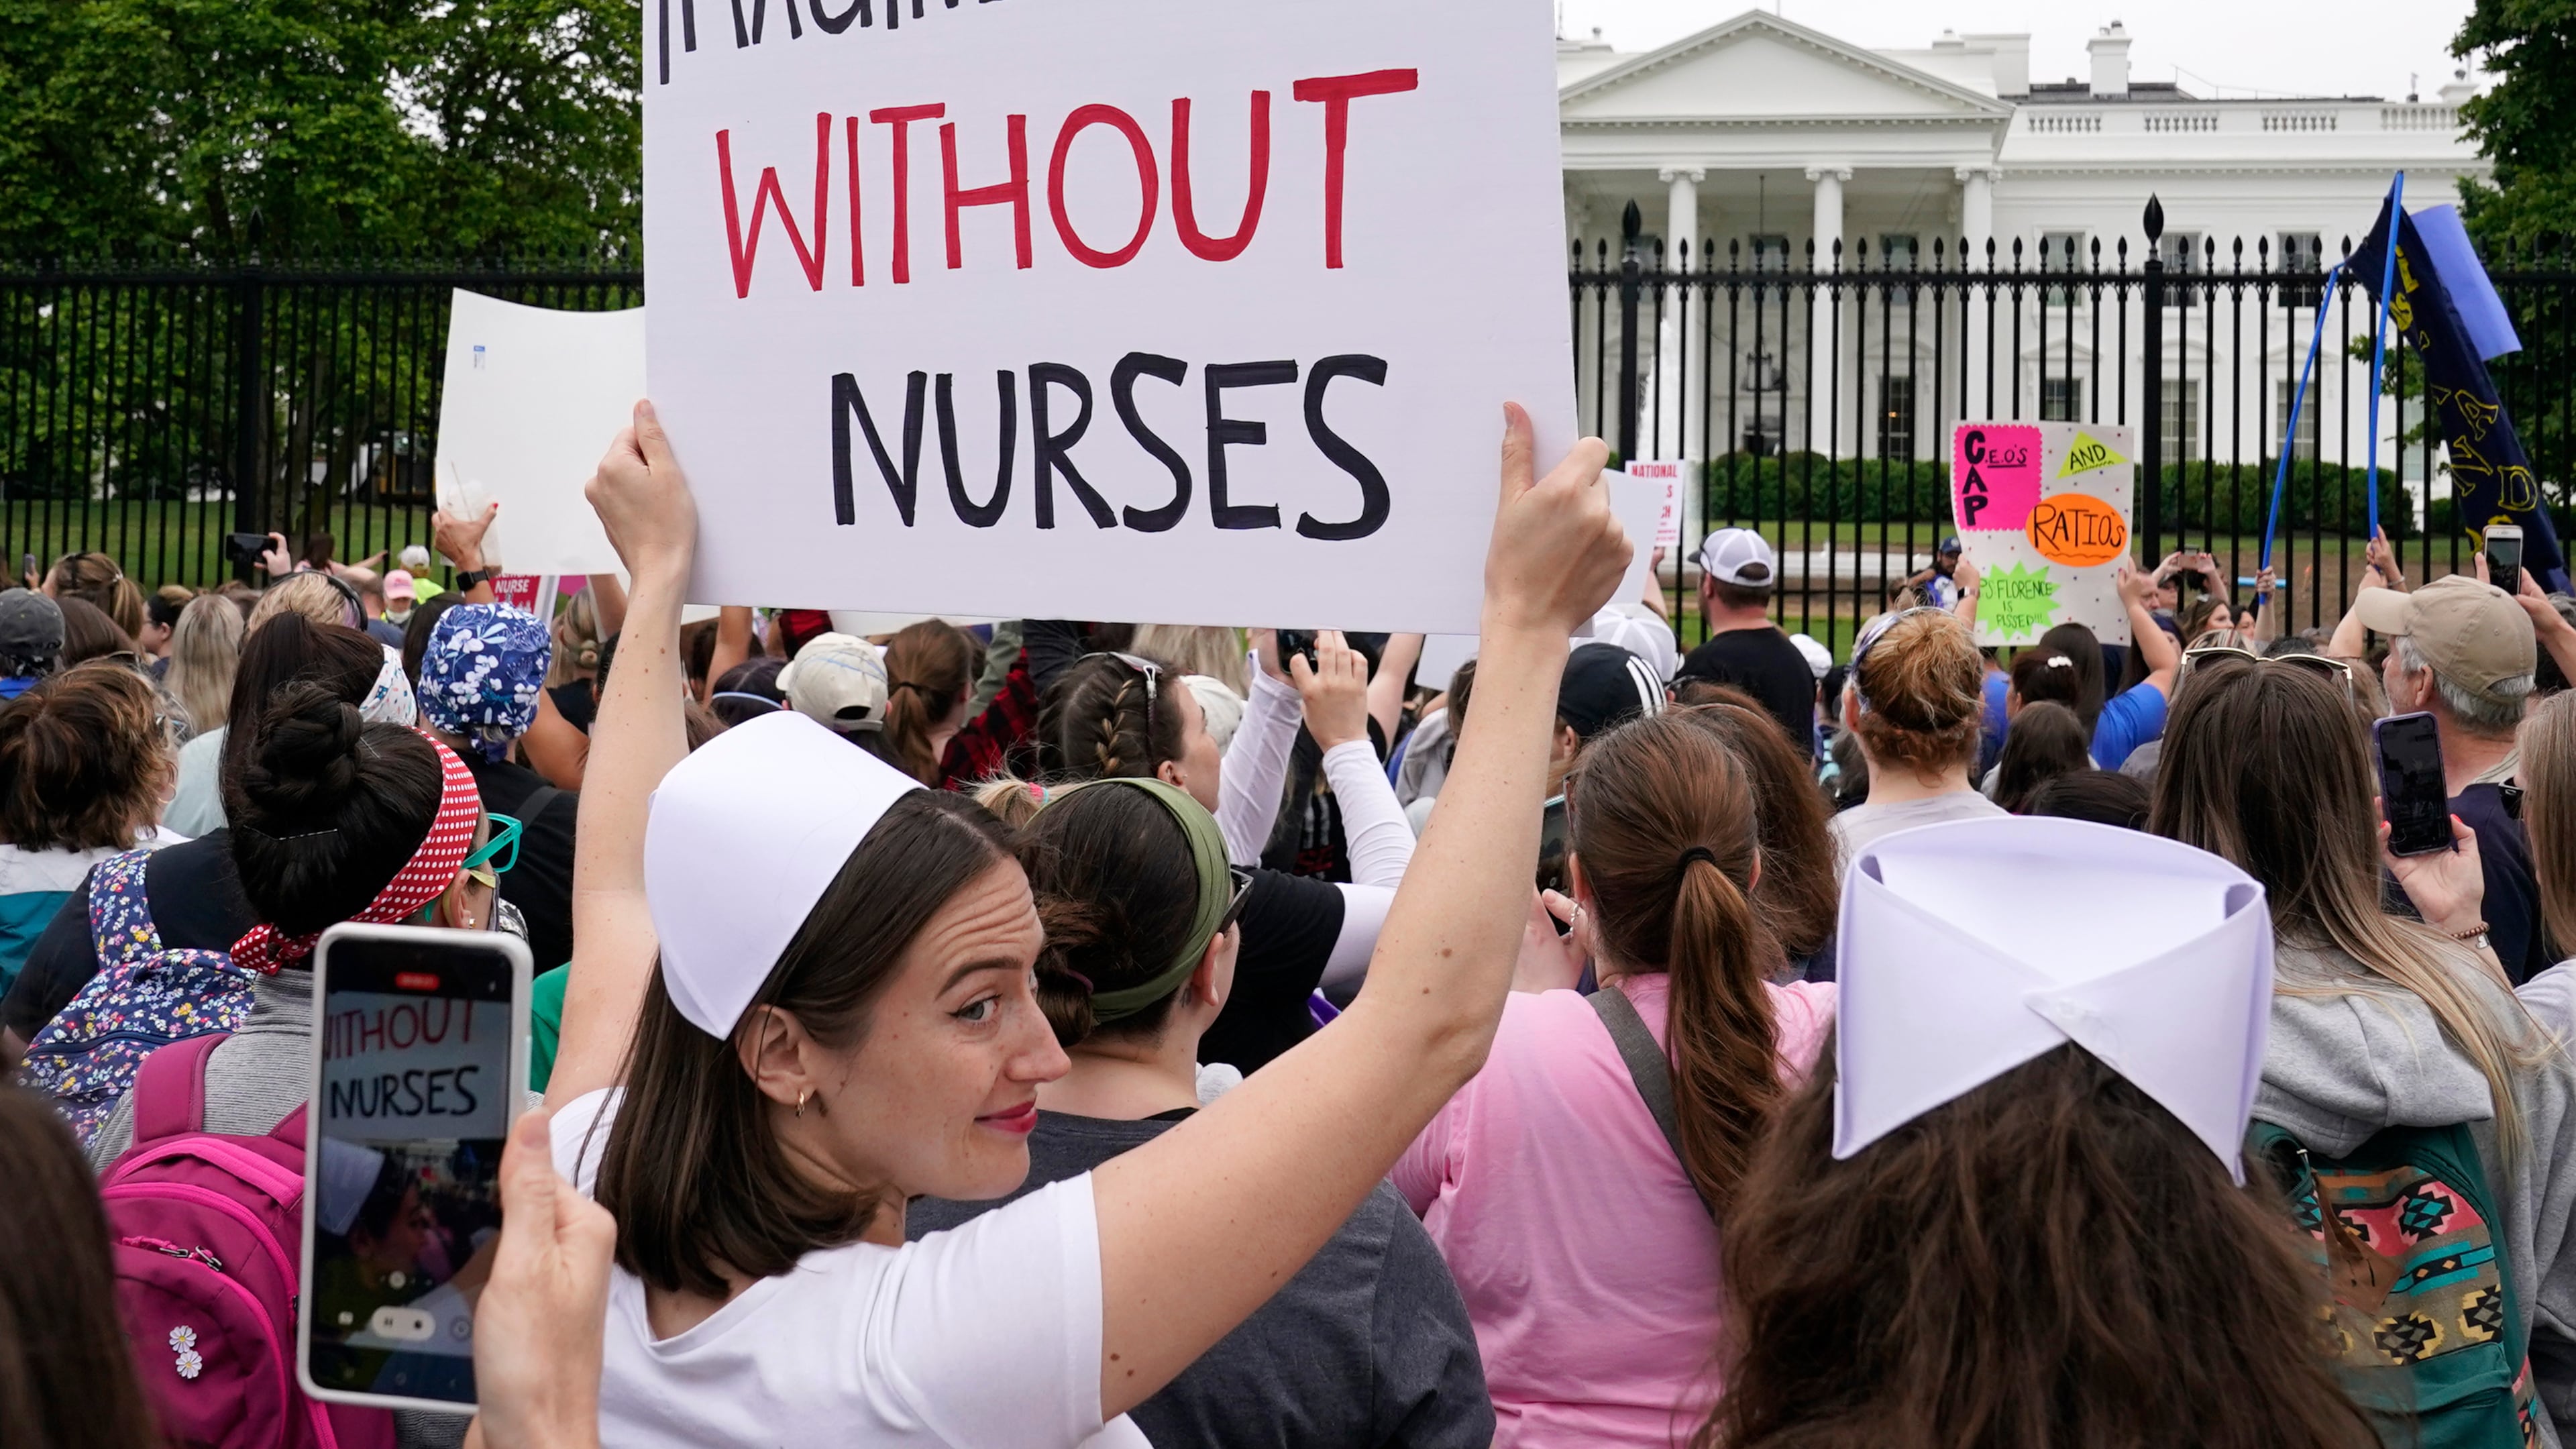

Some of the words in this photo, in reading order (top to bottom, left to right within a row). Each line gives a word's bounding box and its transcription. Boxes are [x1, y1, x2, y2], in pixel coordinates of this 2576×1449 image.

[716, 68, 1418, 299] WITHOUT
[831, 352, 1391, 541] NURSES
[2070, 445, 2106, 470] AND
[1631, 464, 1678, 478] NATIONAL
[494, 579, 530, 594] NURSE
[1997, 579, 2053, 599] FLORENCE
[2002, 600, 2012, 612] IS
[1996, 613, 2043, 629] PISSED!!!
[330, 1065, 480, 1119] NURSES
